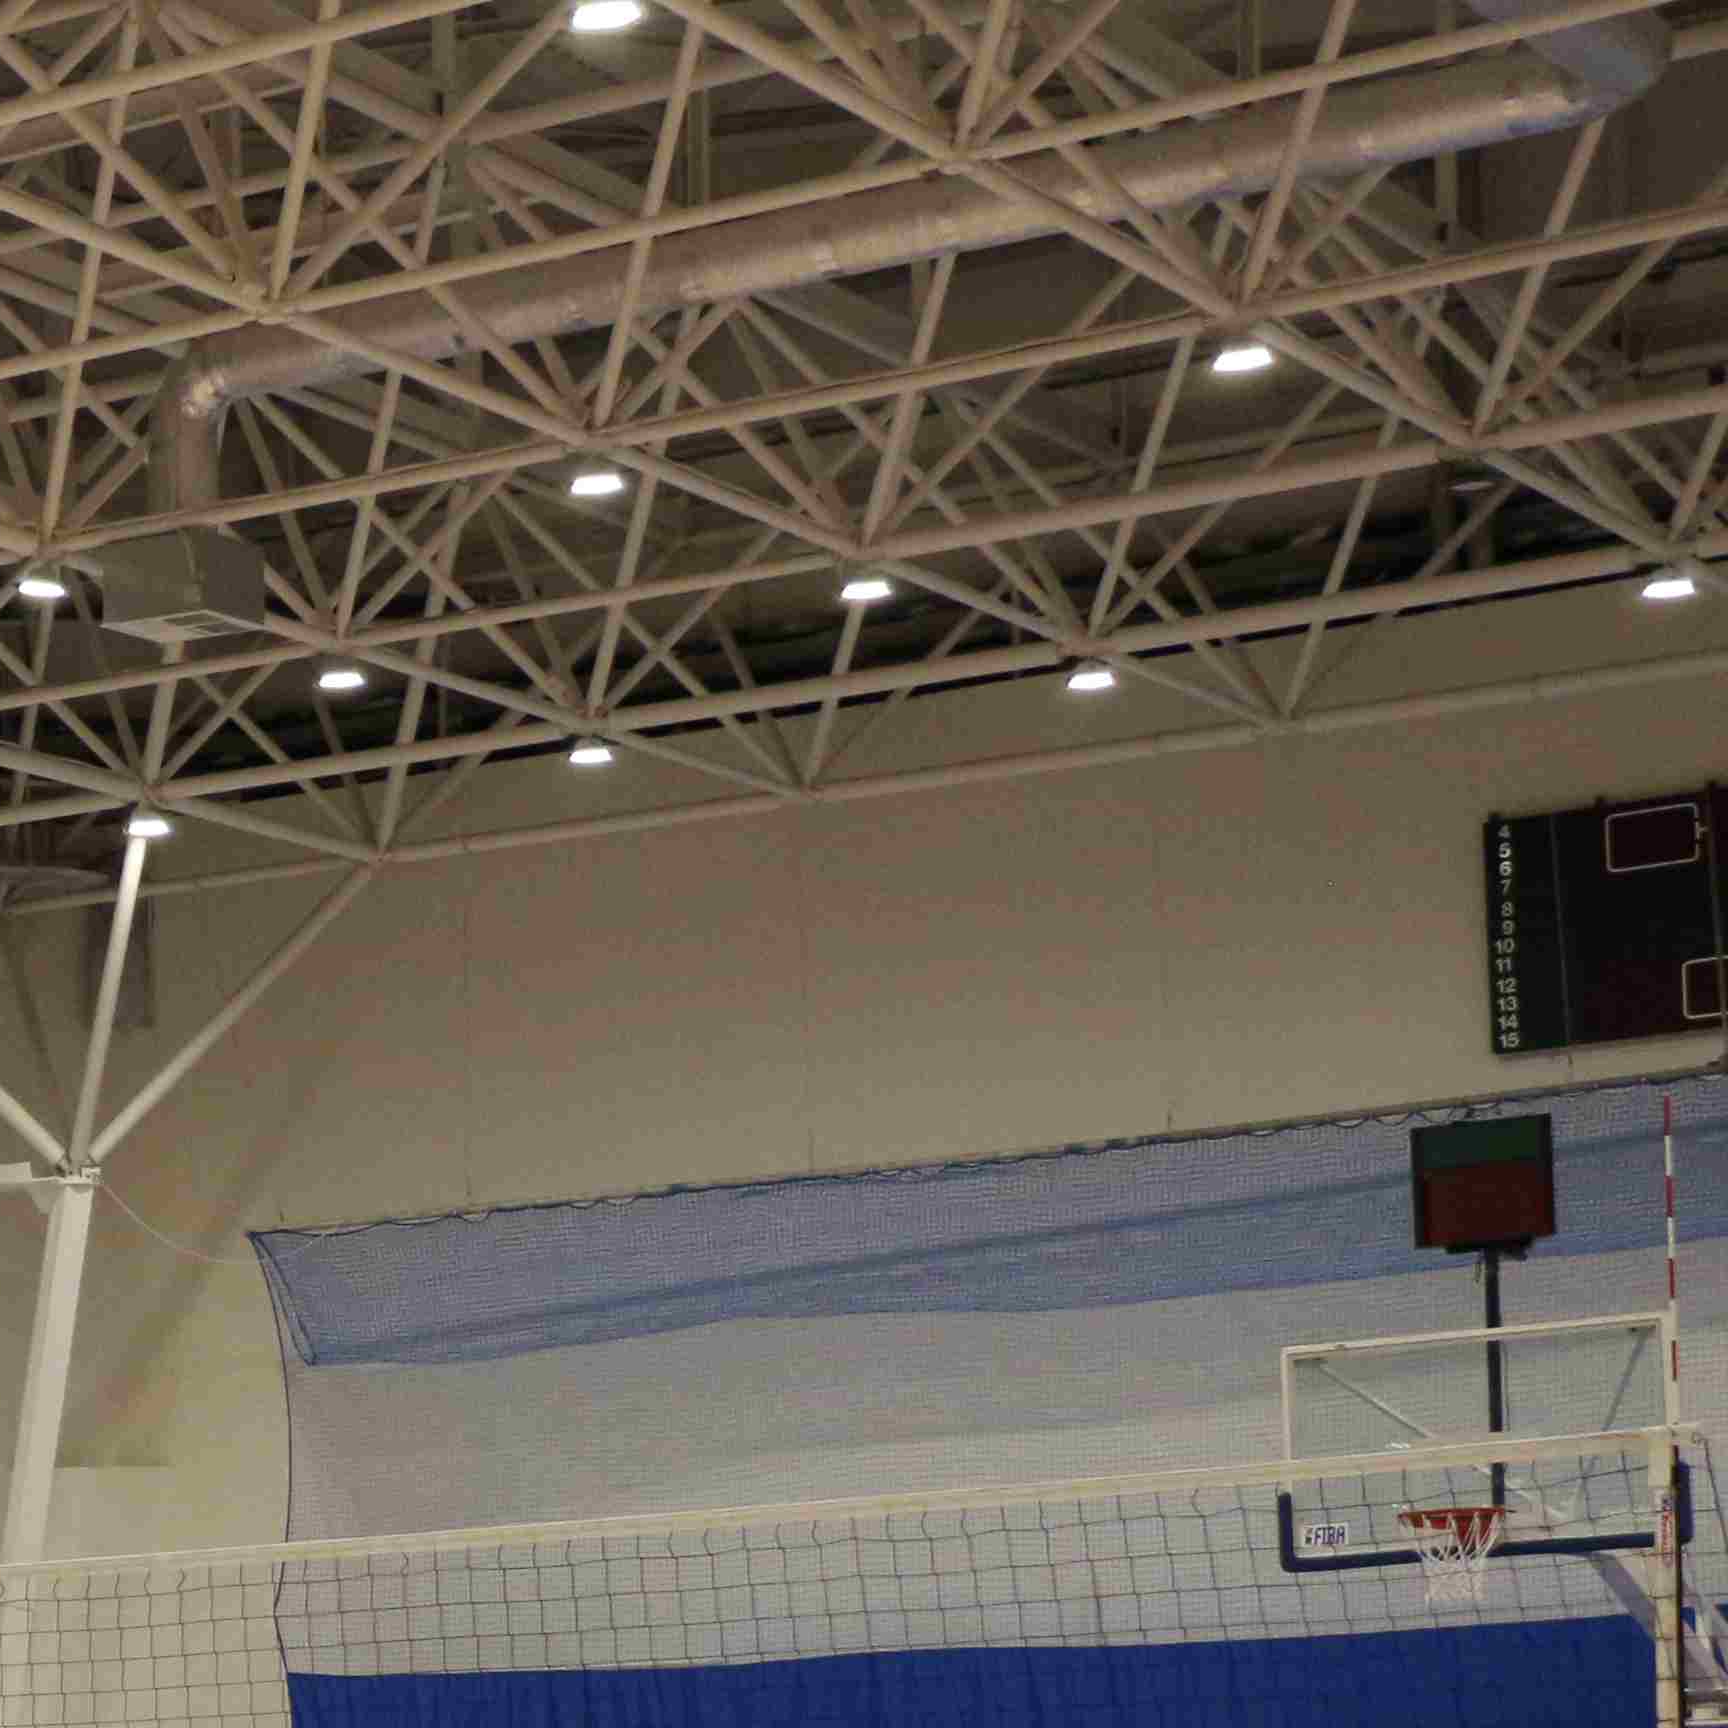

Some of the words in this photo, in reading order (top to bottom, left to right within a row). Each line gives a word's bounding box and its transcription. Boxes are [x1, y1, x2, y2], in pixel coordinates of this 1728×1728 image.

[1499, 842, 1512, 858] 5
[1499, 861, 1512, 877] 6
[1499, 880, 1512, 896] 7
[1501, 901, 1513, 917] 8
[1502, 919, 1514, 935] 9
[1496, 938, 1515, 953] 10
[1496, 957, 1512, 973] 11
[1496, 978, 1517, 993] 12
[1496, 996, 1517, 1011] 13
[1498, 1015, 1518, 1030] 14
[1499, 1033, 1520, 1048] 15
